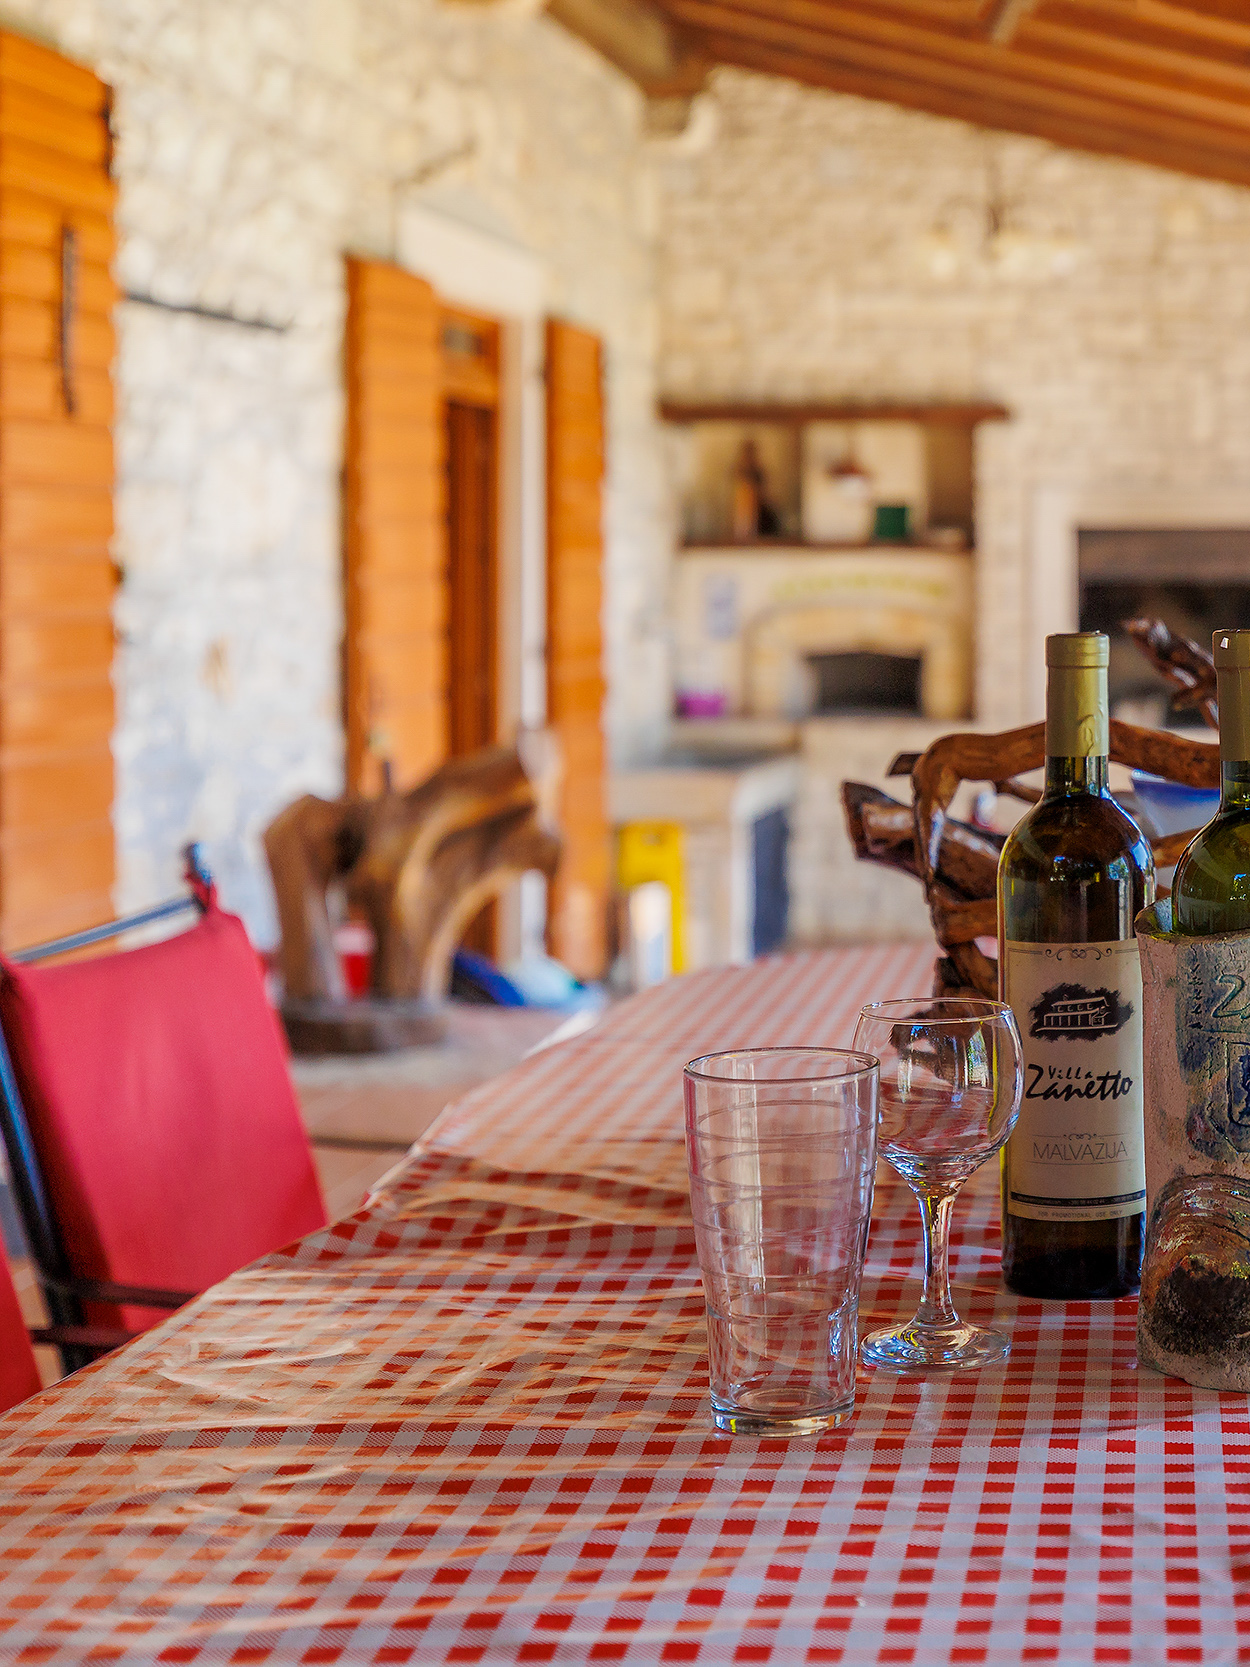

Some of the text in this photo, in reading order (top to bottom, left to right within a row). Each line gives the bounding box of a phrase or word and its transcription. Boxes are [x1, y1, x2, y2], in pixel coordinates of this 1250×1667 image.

[1048, 1065, 1094, 1080] Villa
[1025, 1063, 1134, 1102] Zanetto
[1033, 1141, 1128, 1161] MALVAZIJA
[1051, 1211, 1091, 1219] PROMOTIONAL
